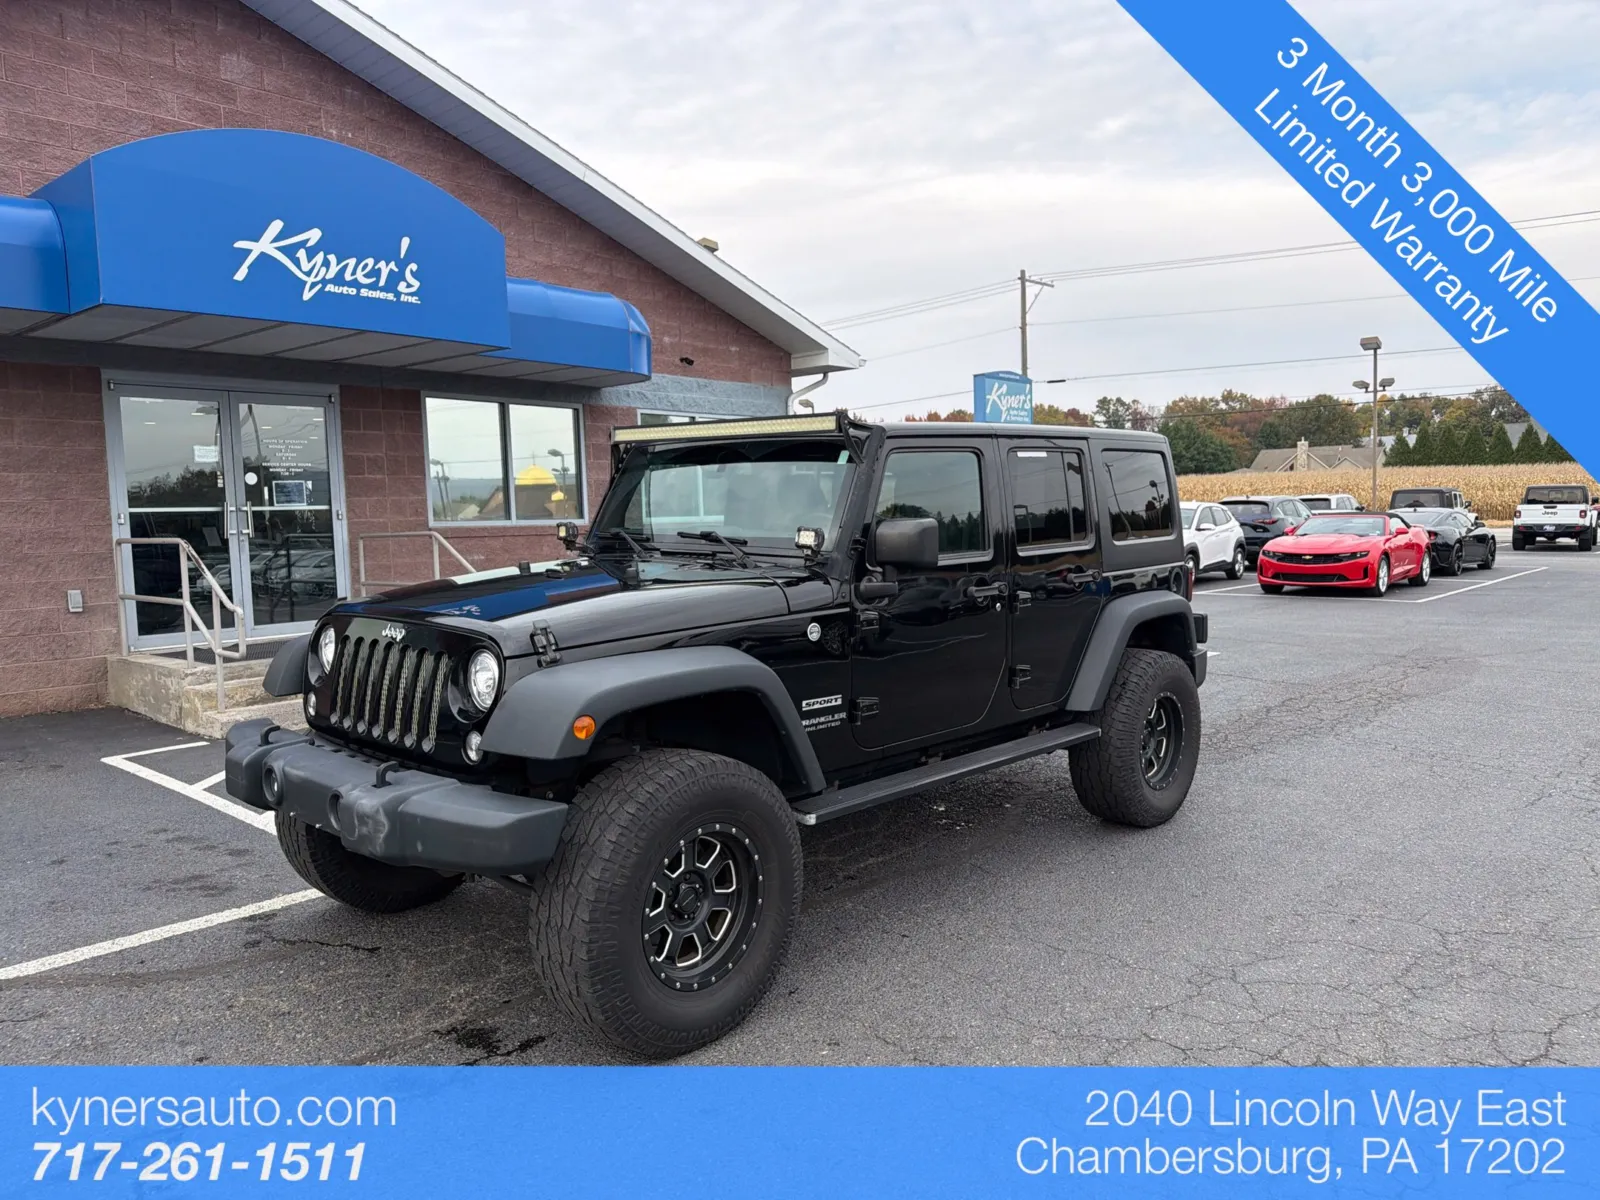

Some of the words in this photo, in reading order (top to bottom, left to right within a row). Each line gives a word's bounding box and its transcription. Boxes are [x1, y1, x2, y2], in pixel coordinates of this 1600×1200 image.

[232, 218, 421, 302] Kyner's
[324, 283, 357, 296] Auto
[359, 288, 398, 302] Sales,
[399, 293, 421, 304] Inc.
[986, 382, 1030, 422] Kyner's
[382, 623, 405, 642] Jeep
[804, 697, 840, 708] SPORT
